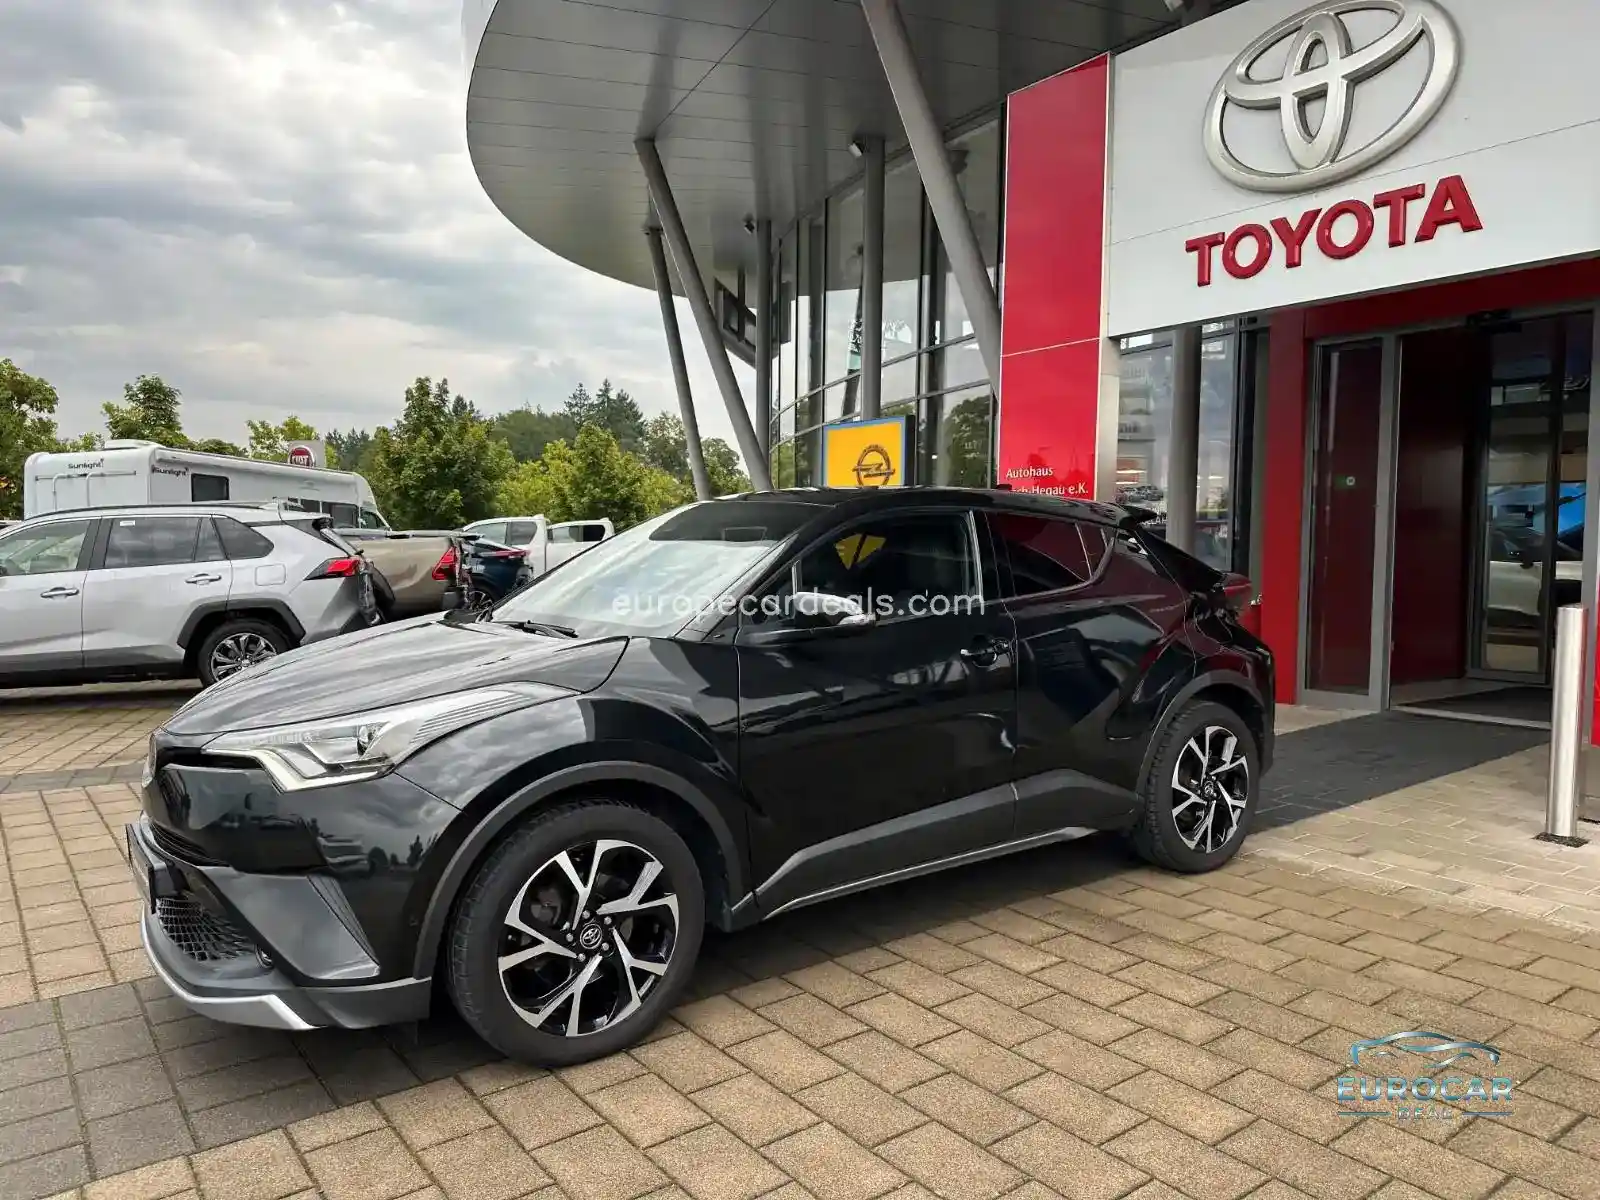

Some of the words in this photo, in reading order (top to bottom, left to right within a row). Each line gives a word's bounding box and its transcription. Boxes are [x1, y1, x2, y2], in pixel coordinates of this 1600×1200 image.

[1185, 175, 1483, 287] TOYOTA
[68, 461, 102, 470] Sunlight
[154, 466, 188, 477] Sunlight
[1006, 465, 1054, 479] Autohaus
[1068, 481, 1089, 494] e.K.
